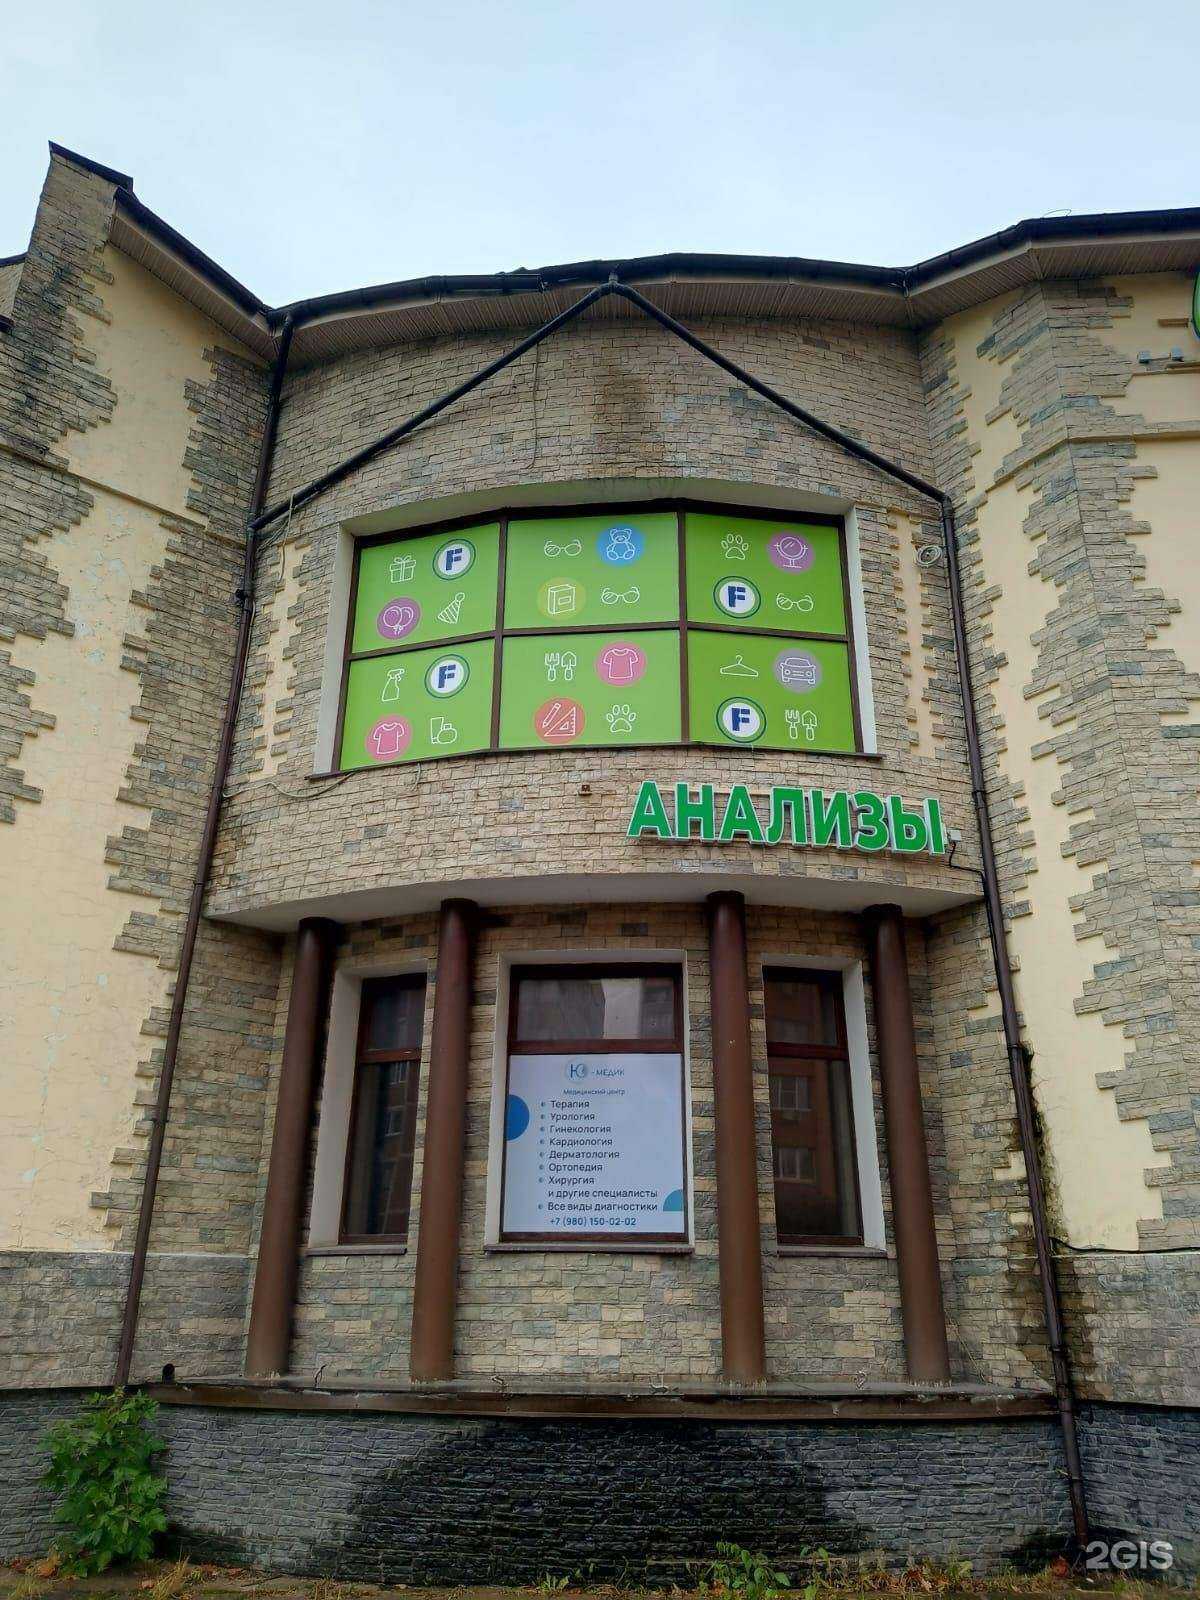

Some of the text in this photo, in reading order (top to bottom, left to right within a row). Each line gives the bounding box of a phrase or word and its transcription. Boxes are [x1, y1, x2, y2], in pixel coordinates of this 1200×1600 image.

[626, 780, 946, 855] АНАЛИЗЫ
[550, 1100, 590, 1110] Терапия
[550, 1112, 595, 1123] Урология
[549, 1125, 612, 1134] Гинекология
[549, 1138, 613, 1148] Кардиология
[548, 1150, 620, 1161] Дерматология
[548, 1162, 603, 1173] Ортопедия
[548, 1175, 595, 1186] Хирургия
[548, 1190, 658, 1200] и другие специалисты
[547, 1201, 658, 1212] Все виды диагностики
[550, 1216, 637, 1227] +7 (980) 150-02-02
